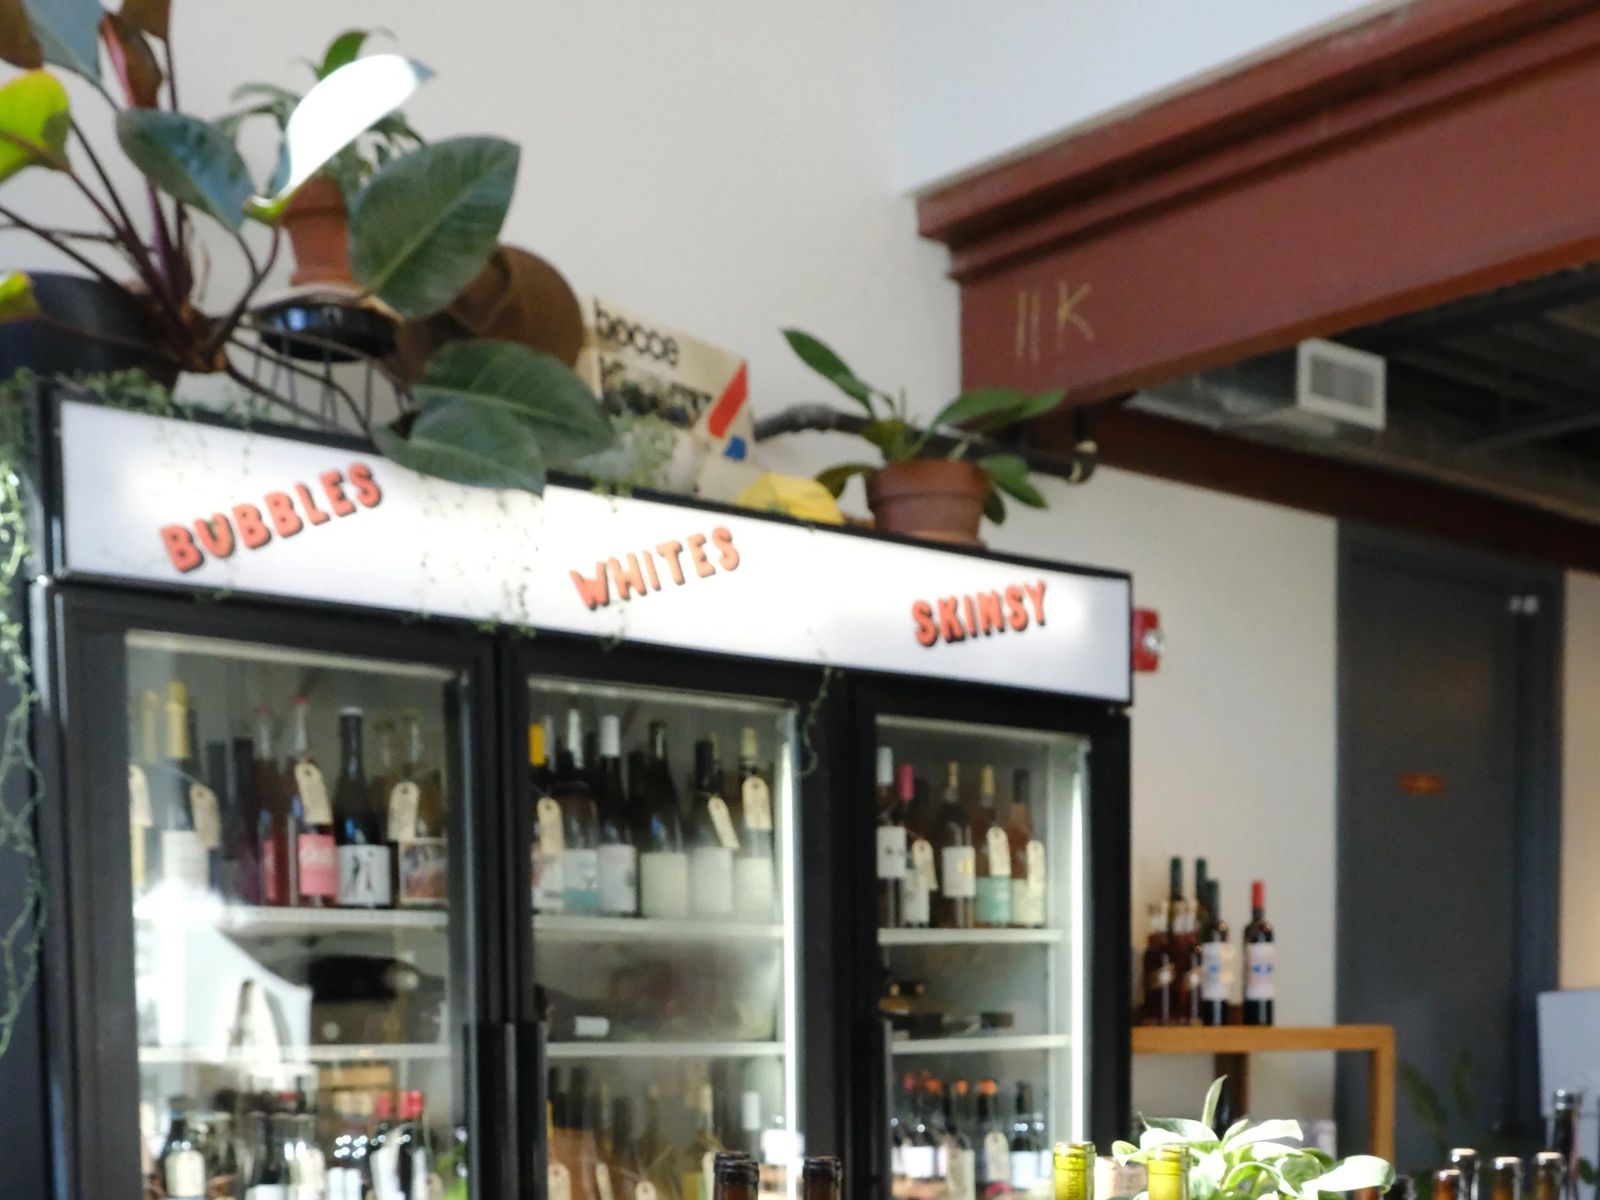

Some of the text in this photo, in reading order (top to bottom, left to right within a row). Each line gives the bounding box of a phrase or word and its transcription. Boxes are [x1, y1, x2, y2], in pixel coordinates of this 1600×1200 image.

[160, 462, 383, 573] BUBBLES
[569, 526, 740, 611] WHITES
[912, 580, 1046, 647] SKINSY
